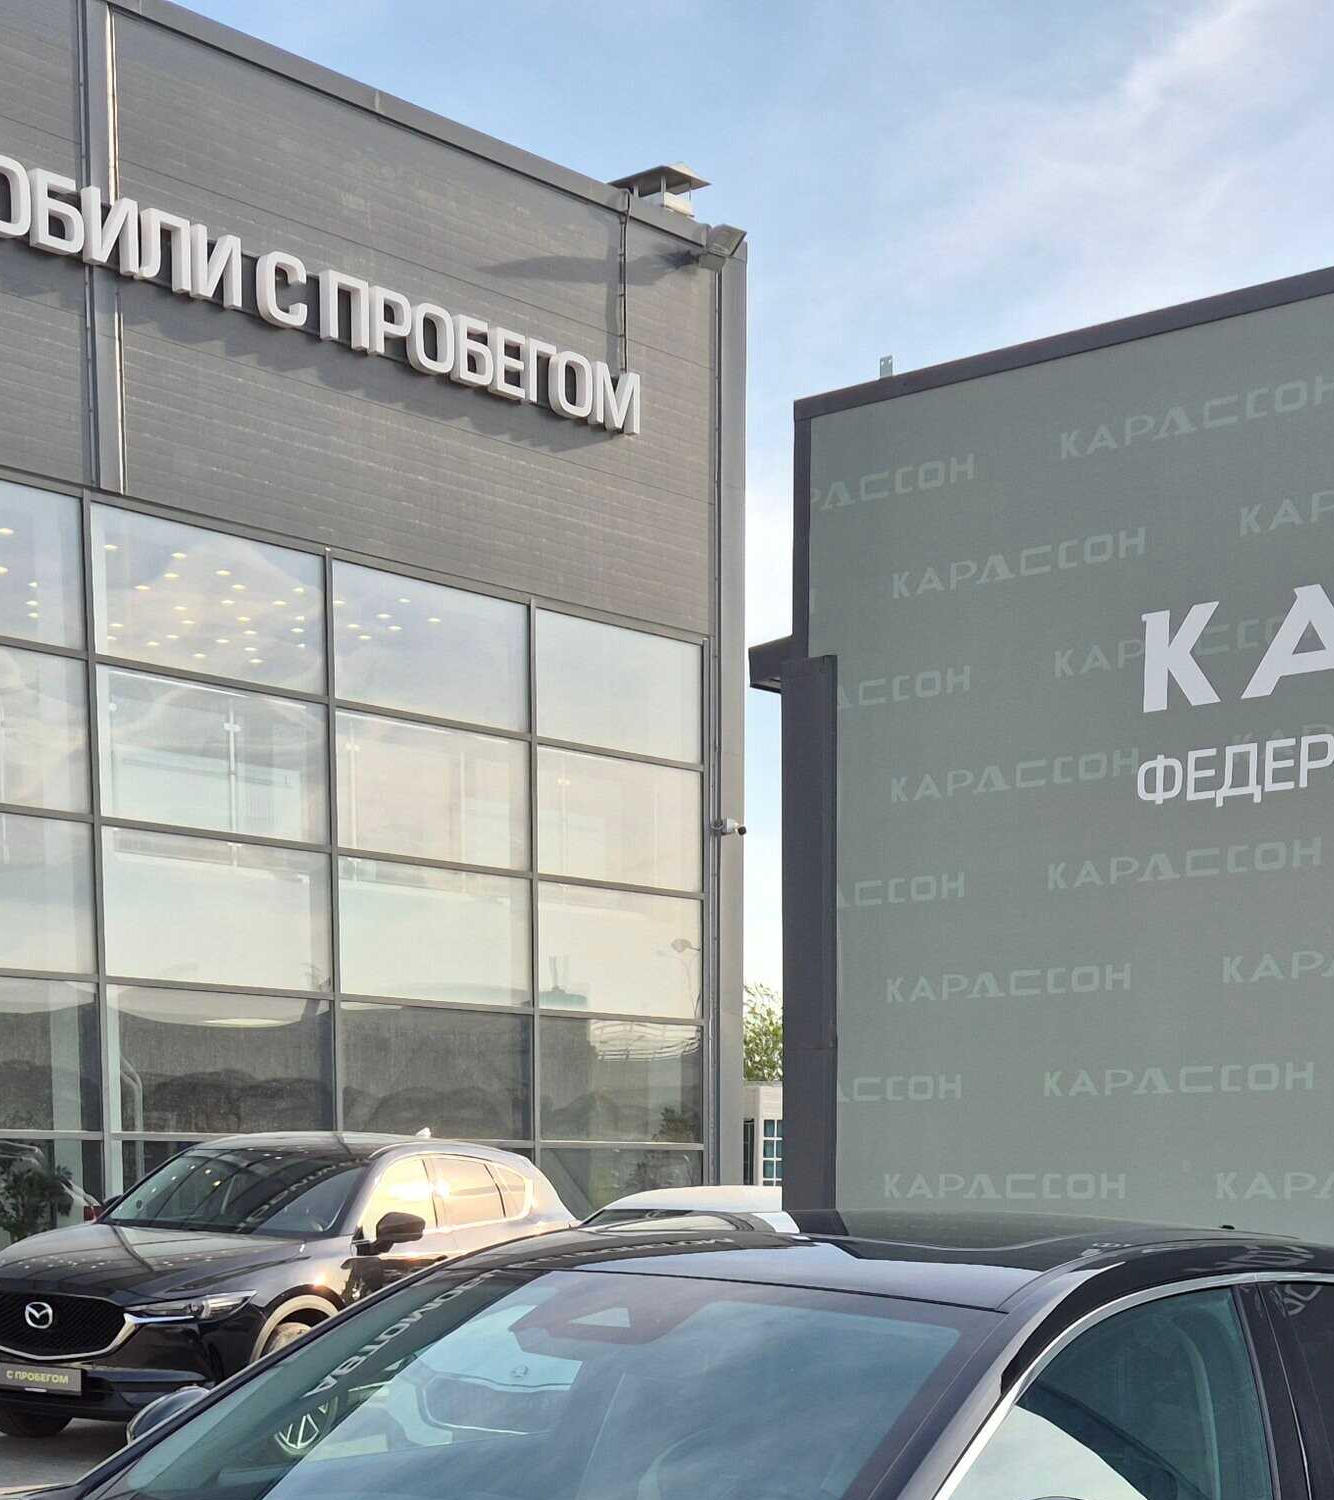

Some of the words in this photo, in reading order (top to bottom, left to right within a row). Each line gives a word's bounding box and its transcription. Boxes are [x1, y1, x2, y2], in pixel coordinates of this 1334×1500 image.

[255, 250, 308, 329] С
[319, 269, 641, 435] ПРОБЕГОМ
[893, 527, 1145, 599] КАРАССОН
[891, 748, 1140, 803] КАРАССОН
[1048, 837, 1321, 890] КАРАССОН
[887, 963, 1131, 1003] КАРАССОН
[1044, 1062, 1314, 1098] КАРАССОН
[883, 1173, 1126, 1201] КАРАССОН
[5, 1370, 14, 1380] С
[14, 1371, 69, 1385] ПРОБЕГОМ
